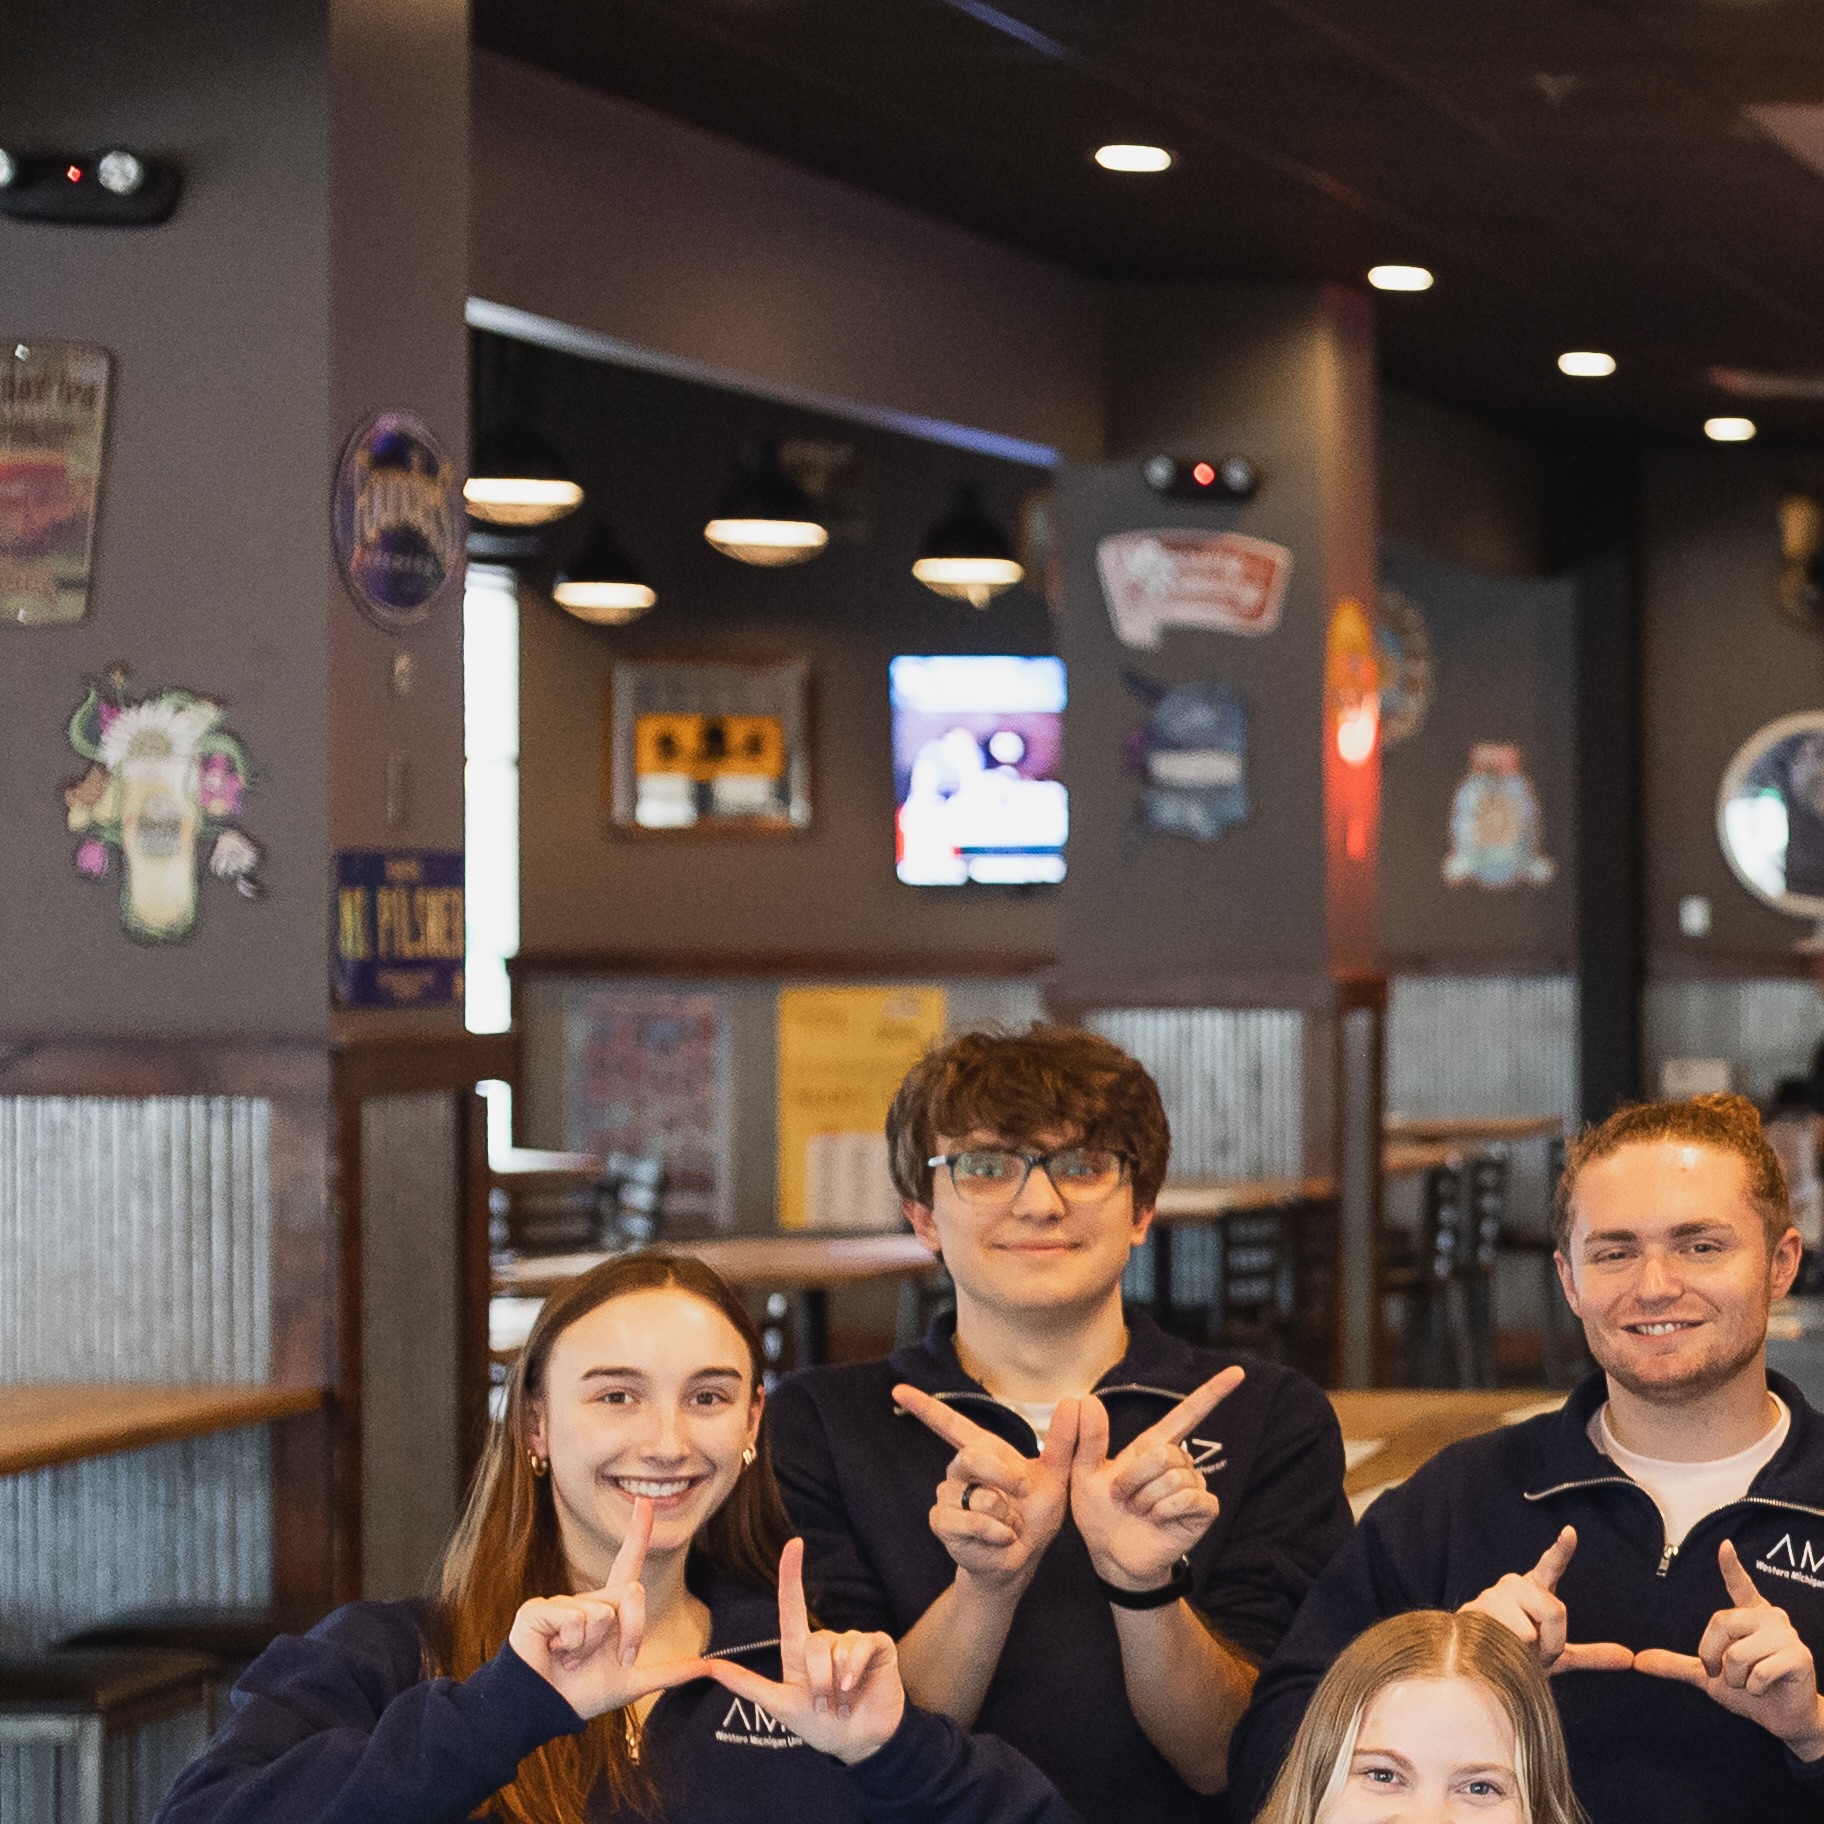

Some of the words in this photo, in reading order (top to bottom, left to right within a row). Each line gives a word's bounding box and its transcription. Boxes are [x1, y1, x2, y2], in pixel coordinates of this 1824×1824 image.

[1756, 1560, 1790, 1579] Western
[715, 1730, 748, 1745] Western
[749, 1735, 787, 1750] Michigan
